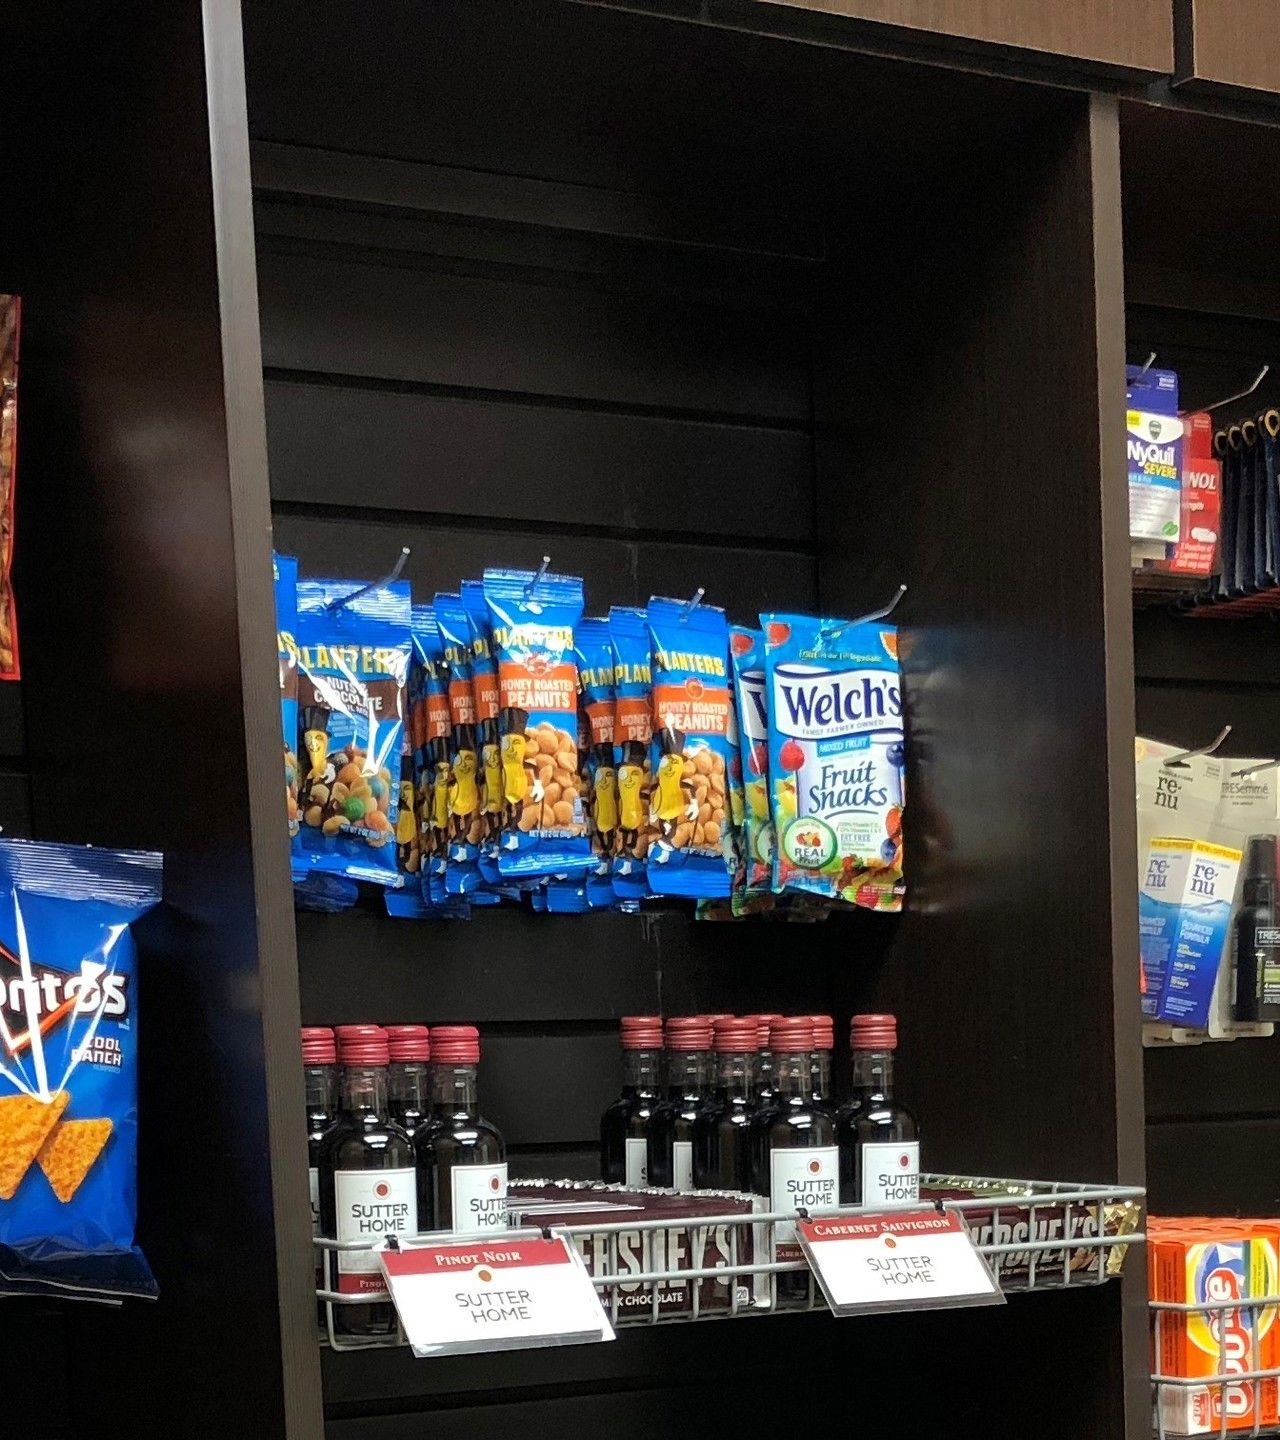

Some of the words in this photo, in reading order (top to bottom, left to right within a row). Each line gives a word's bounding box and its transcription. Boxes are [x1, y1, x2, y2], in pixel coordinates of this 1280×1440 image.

[1127, 440, 1175, 466] NyQuil
[655, 650, 725, 676] PLANTERS
[500, 679, 532, 692] HONEY
[535, 679, 573, 693] ROASTED
[508, 690, 570, 709] PEANUTS
[780, 678, 902, 727] Welch's
[659, 702, 690, 713] HONEY
[692, 702, 728, 715] ROASTED
[665, 713, 725, 731] PEANUTS
[821, 761, 876, 792] Fruit
[808, 785, 888, 815] Snacks
[1155, 792, 1178, 811] nu
[795, 848, 826, 857] REAL
[1190, 879, 1215, 895] nu
[85, 1037, 121, 1051] COOL
[786, 1178, 835, 1193] SUTTER
[793, 1192, 833, 1206] HOME
[351, 1203, 409, 1218] SUTTER
[359, 1218, 406, 1233] HOME
[814, 1222, 878, 1237] CABERNET
[880, 1217, 951, 1233] SAUVIGNON
[434, 1253, 480, 1266] PINOT
[483, 1250, 522, 1263] NOIR
[574, 1225, 733, 1293] ERSHEY'S
[866, 1255, 934, 1272] SUTTER
[882, 1270, 935, 1286] HOME
[455, 1290, 532, 1308] SUTTER
[471, 1306, 532, 1323] HOME
